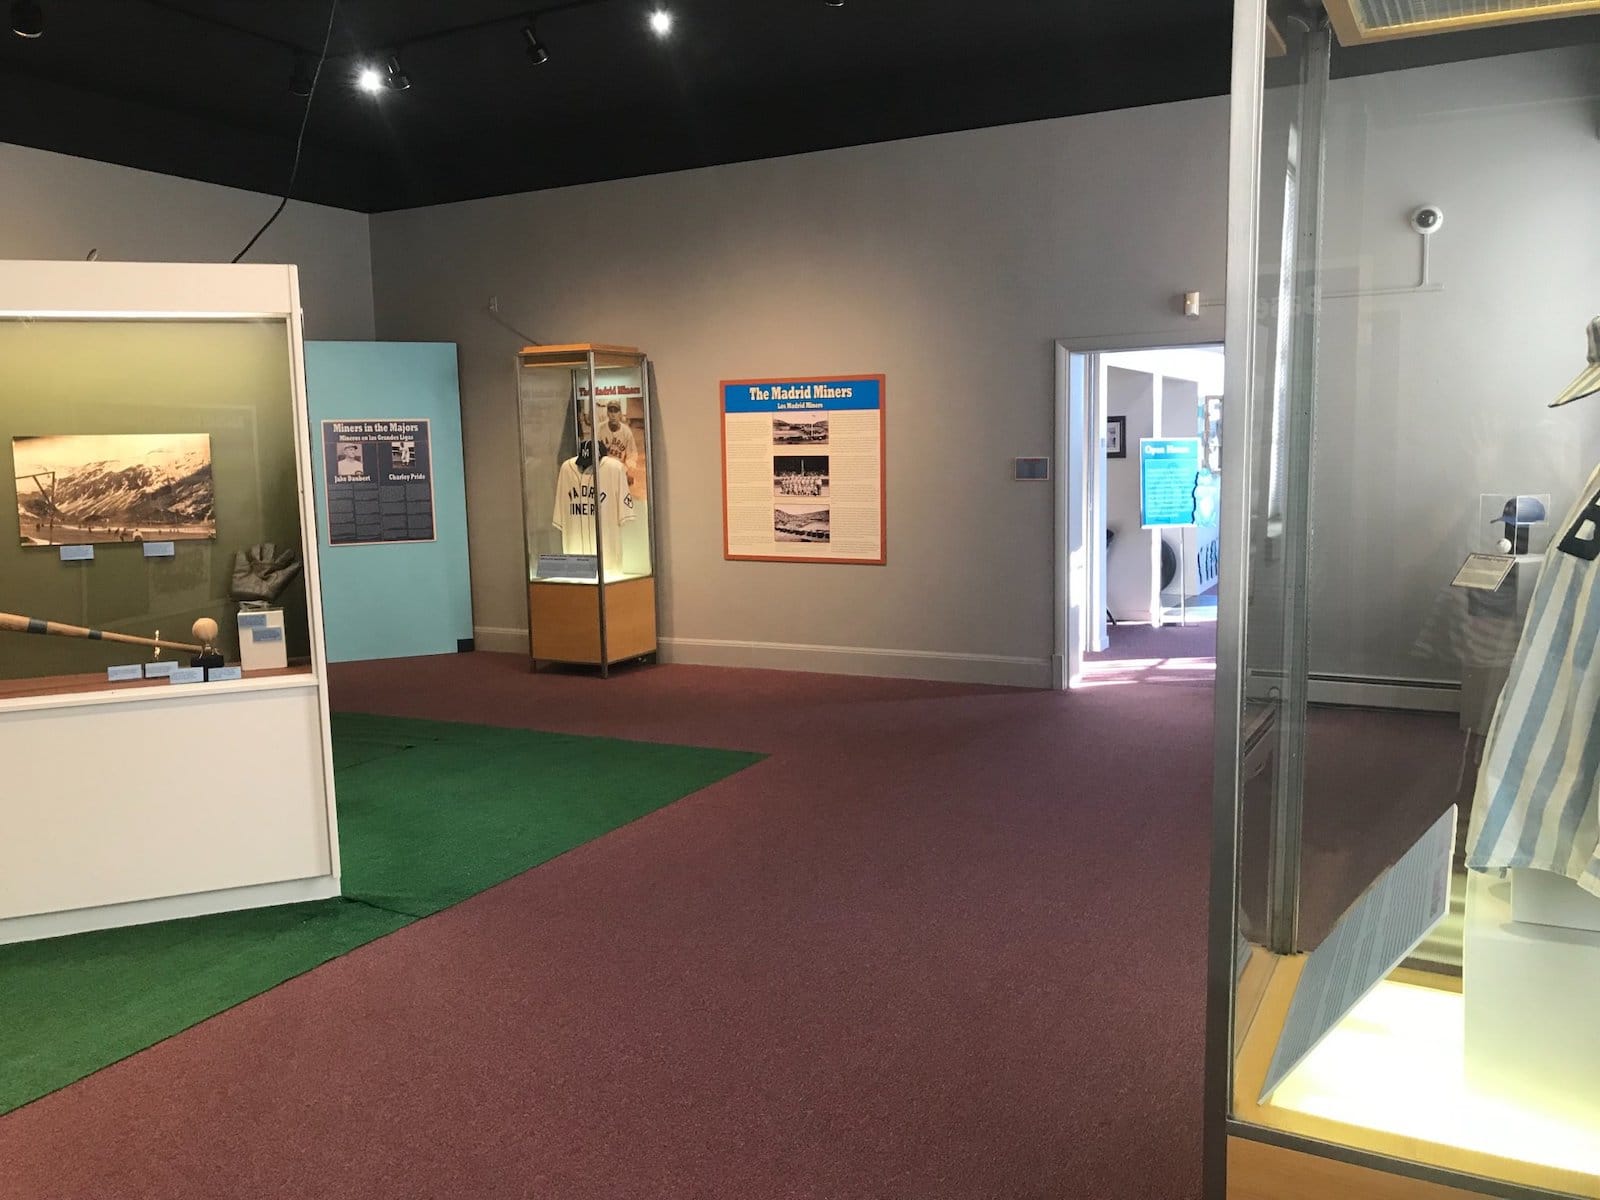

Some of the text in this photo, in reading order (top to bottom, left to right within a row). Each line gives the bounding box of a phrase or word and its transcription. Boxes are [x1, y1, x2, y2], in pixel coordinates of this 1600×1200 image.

[749, 384, 853, 400] The Madrid Miners
[333, 422, 419, 434] Miners in the Majors
[388, 473, 426, 482] Charley Pride
